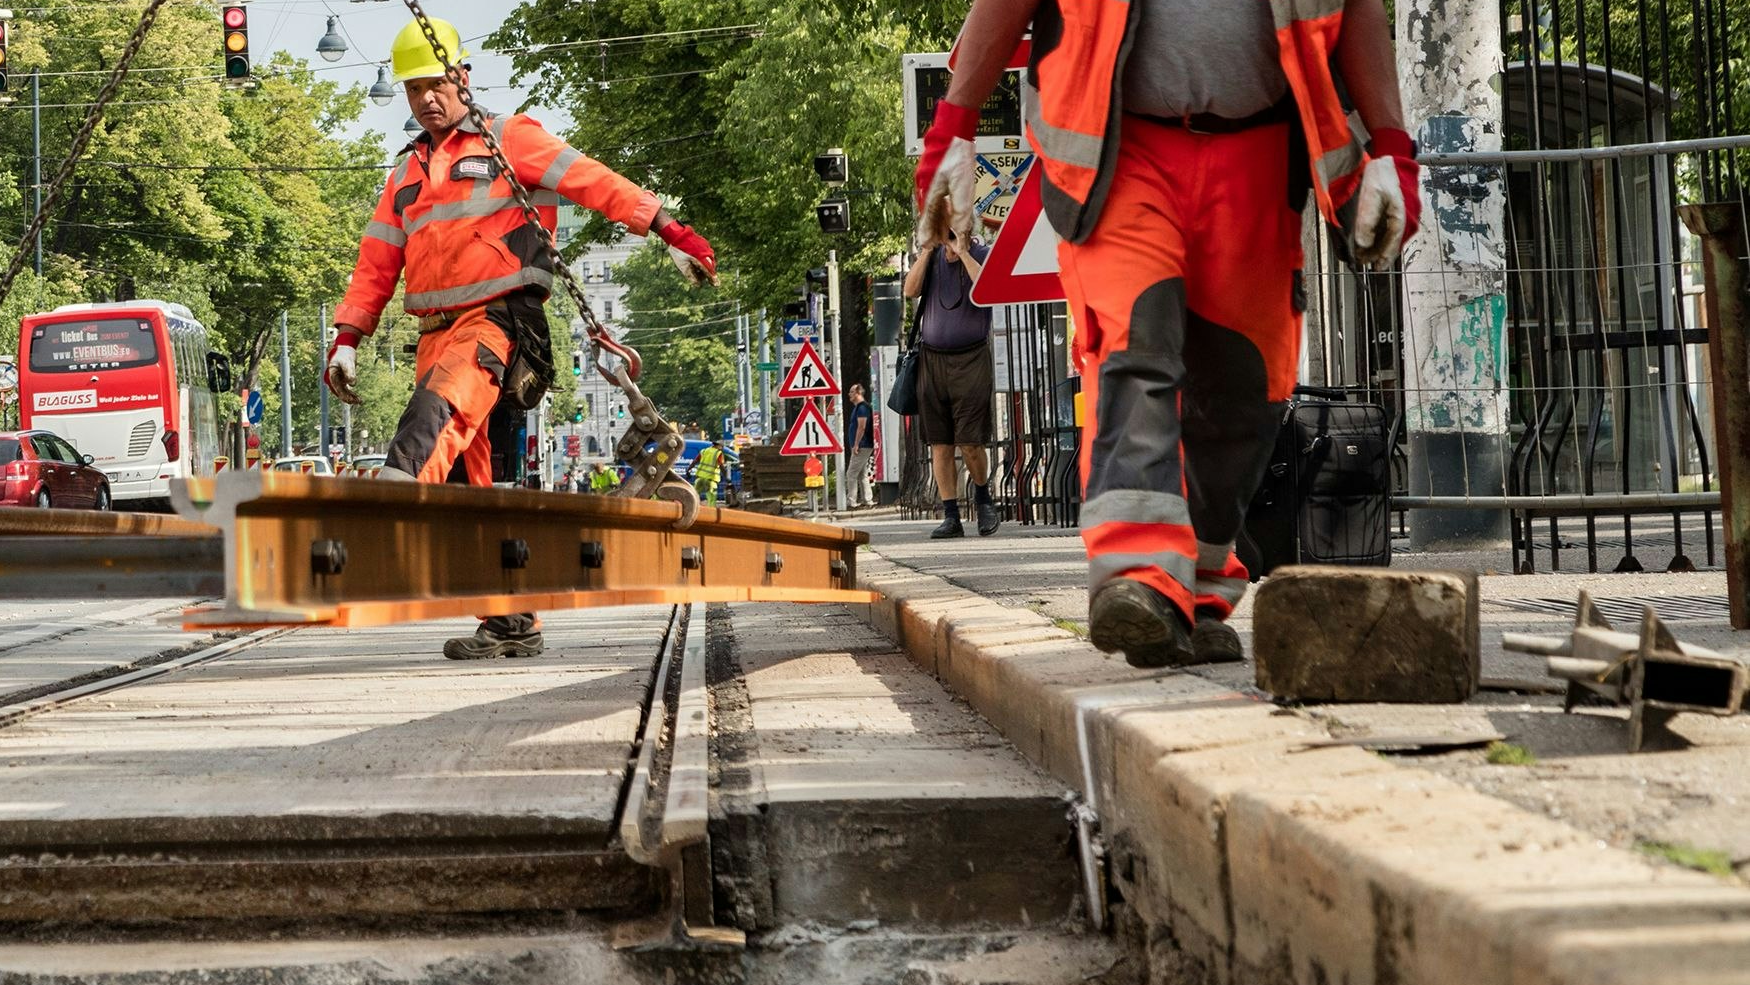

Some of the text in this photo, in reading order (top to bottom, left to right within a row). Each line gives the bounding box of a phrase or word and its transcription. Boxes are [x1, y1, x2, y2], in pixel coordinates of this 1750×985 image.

[61, 330, 84, 344] ticket
[69, 361, 120, 370] SETRA
[38, 394, 93, 407] BLAGUSS
